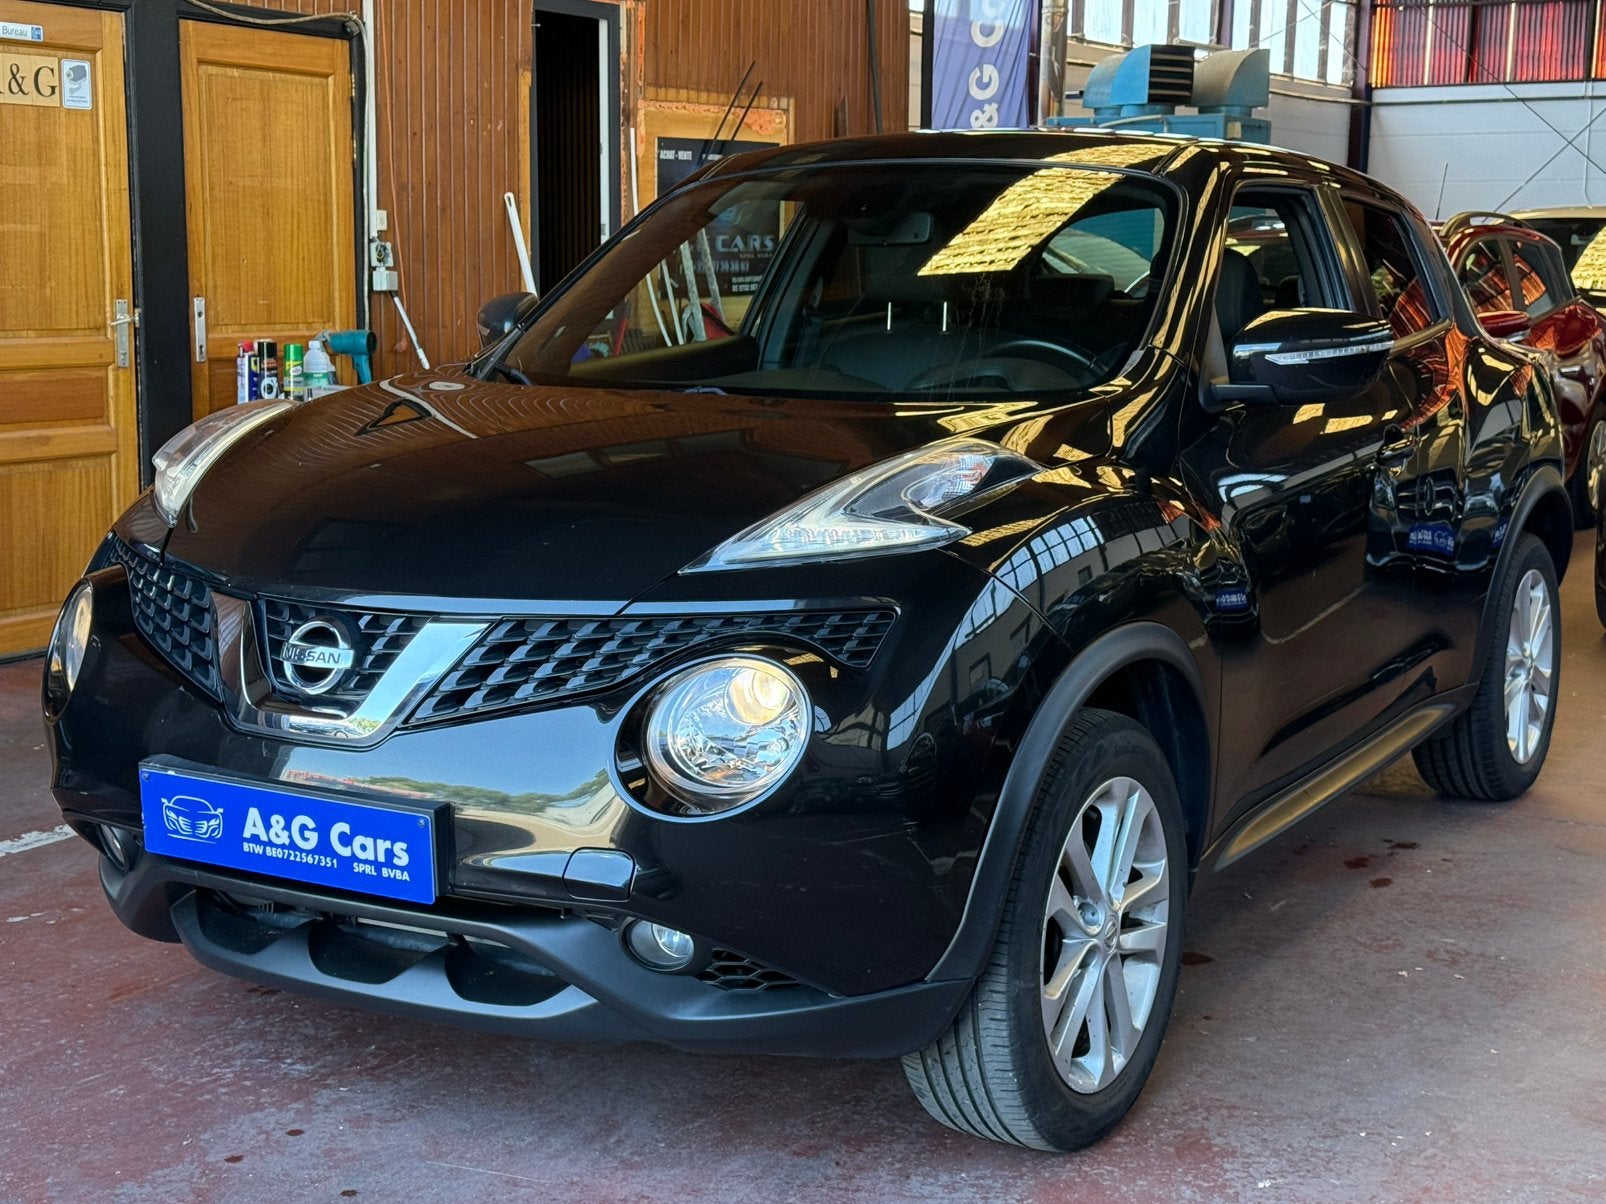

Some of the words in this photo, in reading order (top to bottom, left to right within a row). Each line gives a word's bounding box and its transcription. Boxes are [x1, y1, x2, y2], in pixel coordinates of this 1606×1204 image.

[2, 25, 28, 37] Bureau
[0, 62, 58, 98] &G
[715, 234, 776, 252] CARS
[282, 642, 342, 664] NISSAN
[242, 806, 319, 851] A&G
[329, 821, 410, 867] Cars
[242, 841, 264, 855] BTW
[265, 846, 338, 869] BE0722567351
[352, 861, 377, 876] SPRL
[381, 867, 411, 882] BVBA
